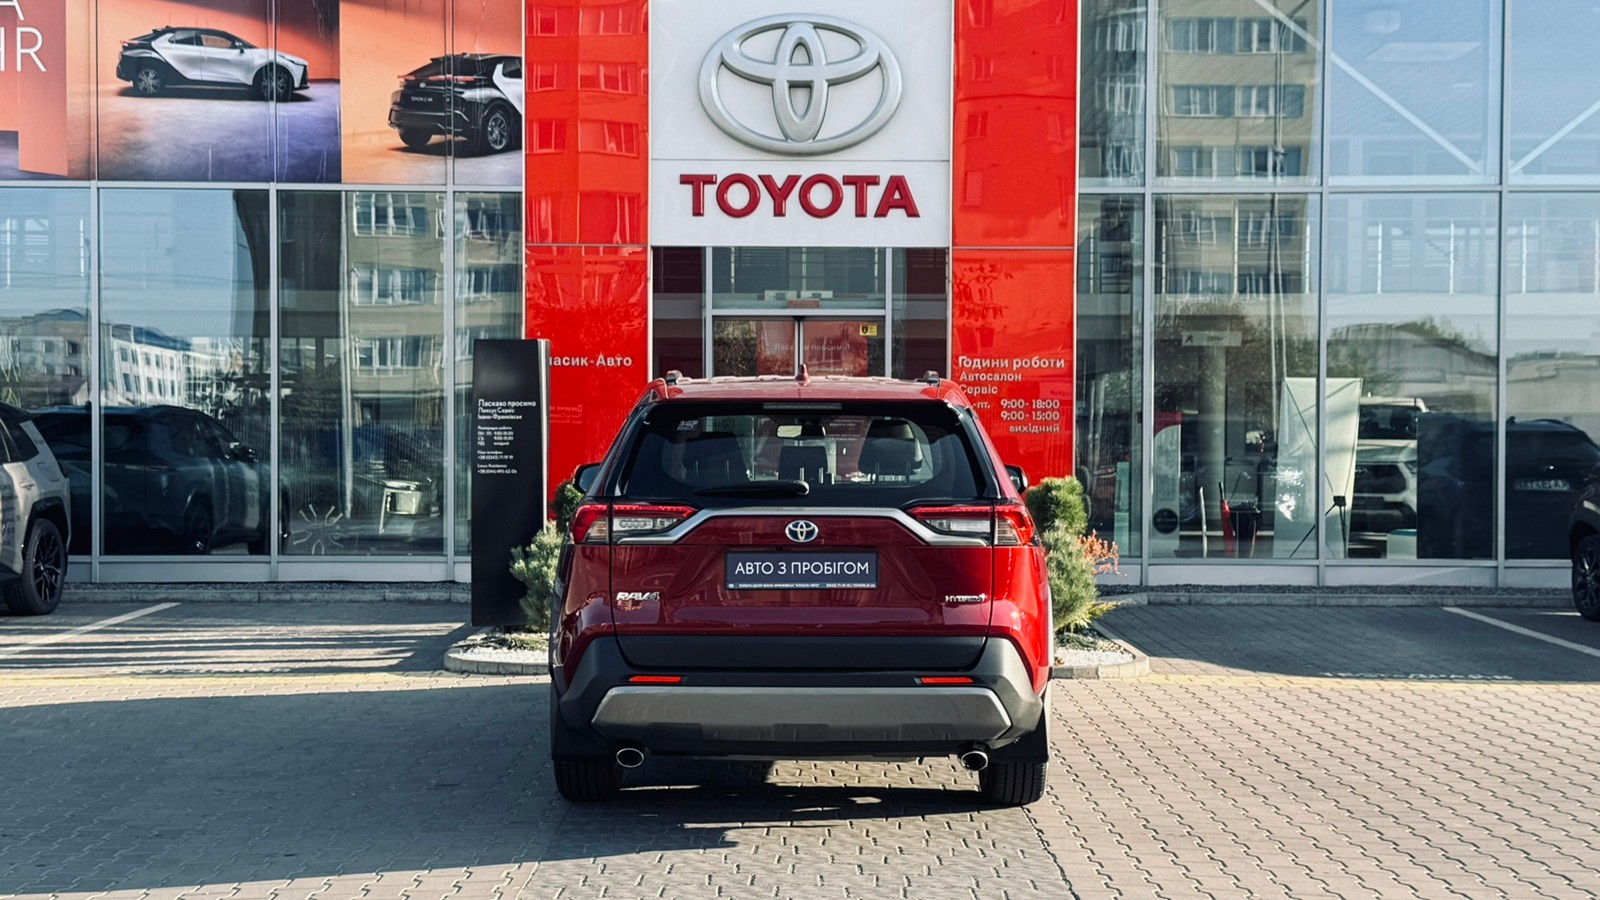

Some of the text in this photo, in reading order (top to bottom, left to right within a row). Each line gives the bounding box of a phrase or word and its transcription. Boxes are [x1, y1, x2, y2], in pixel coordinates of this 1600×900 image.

[679, 172, 921, 219] TOYOTA
[958, 355, 1065, 371] Години роботи
[959, 372, 1022, 382] Автосалон
[508, 400, 537, 408] просимо
[1009, 423, 1060, 434] вихідний
[734, 561, 870, 576] АВТО З ПРОБІГОМ
[616, 591, 661, 601] RAV4
[945, 594, 983, 603] HYBRID
